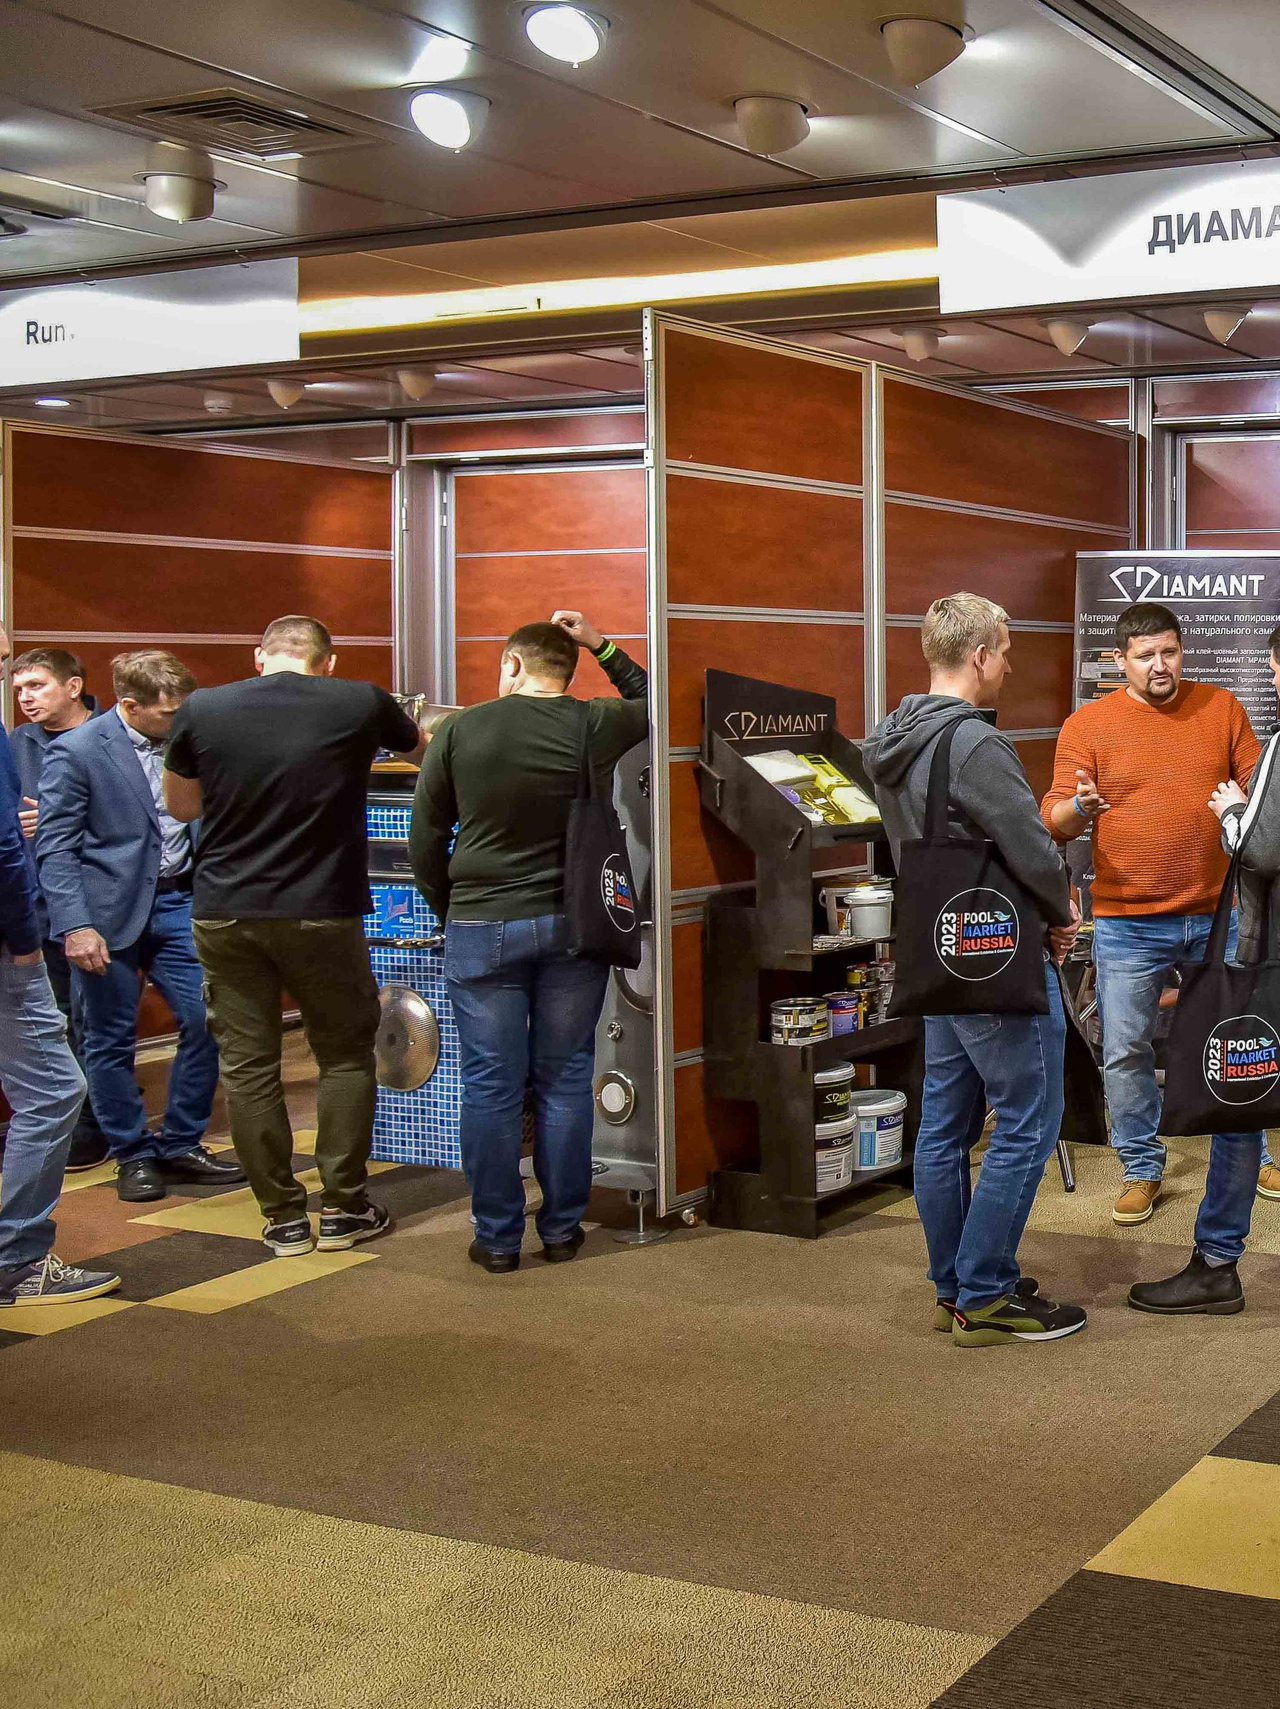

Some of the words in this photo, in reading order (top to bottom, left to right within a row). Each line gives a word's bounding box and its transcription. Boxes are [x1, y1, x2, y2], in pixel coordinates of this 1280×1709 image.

[1080, 613, 1120, 622] Материал
[1234, 613, 1280, 623] полировки
[1088, 627, 1116, 635] защит
[1190, 626, 1250, 636] натурального
[605, 868, 616, 906] 2023
[941, 912, 957, 956] 2023
[963, 922, 1013, 937] MARKET
[962, 936, 1014, 951] RUSSIA
[1228, 1038, 1259, 1051] POOL
[1207, 1037, 1221, 1081] 2023
[1227, 1047, 1276, 1064] MARKET
[1227, 1061, 1279, 1077] RUSSIA
